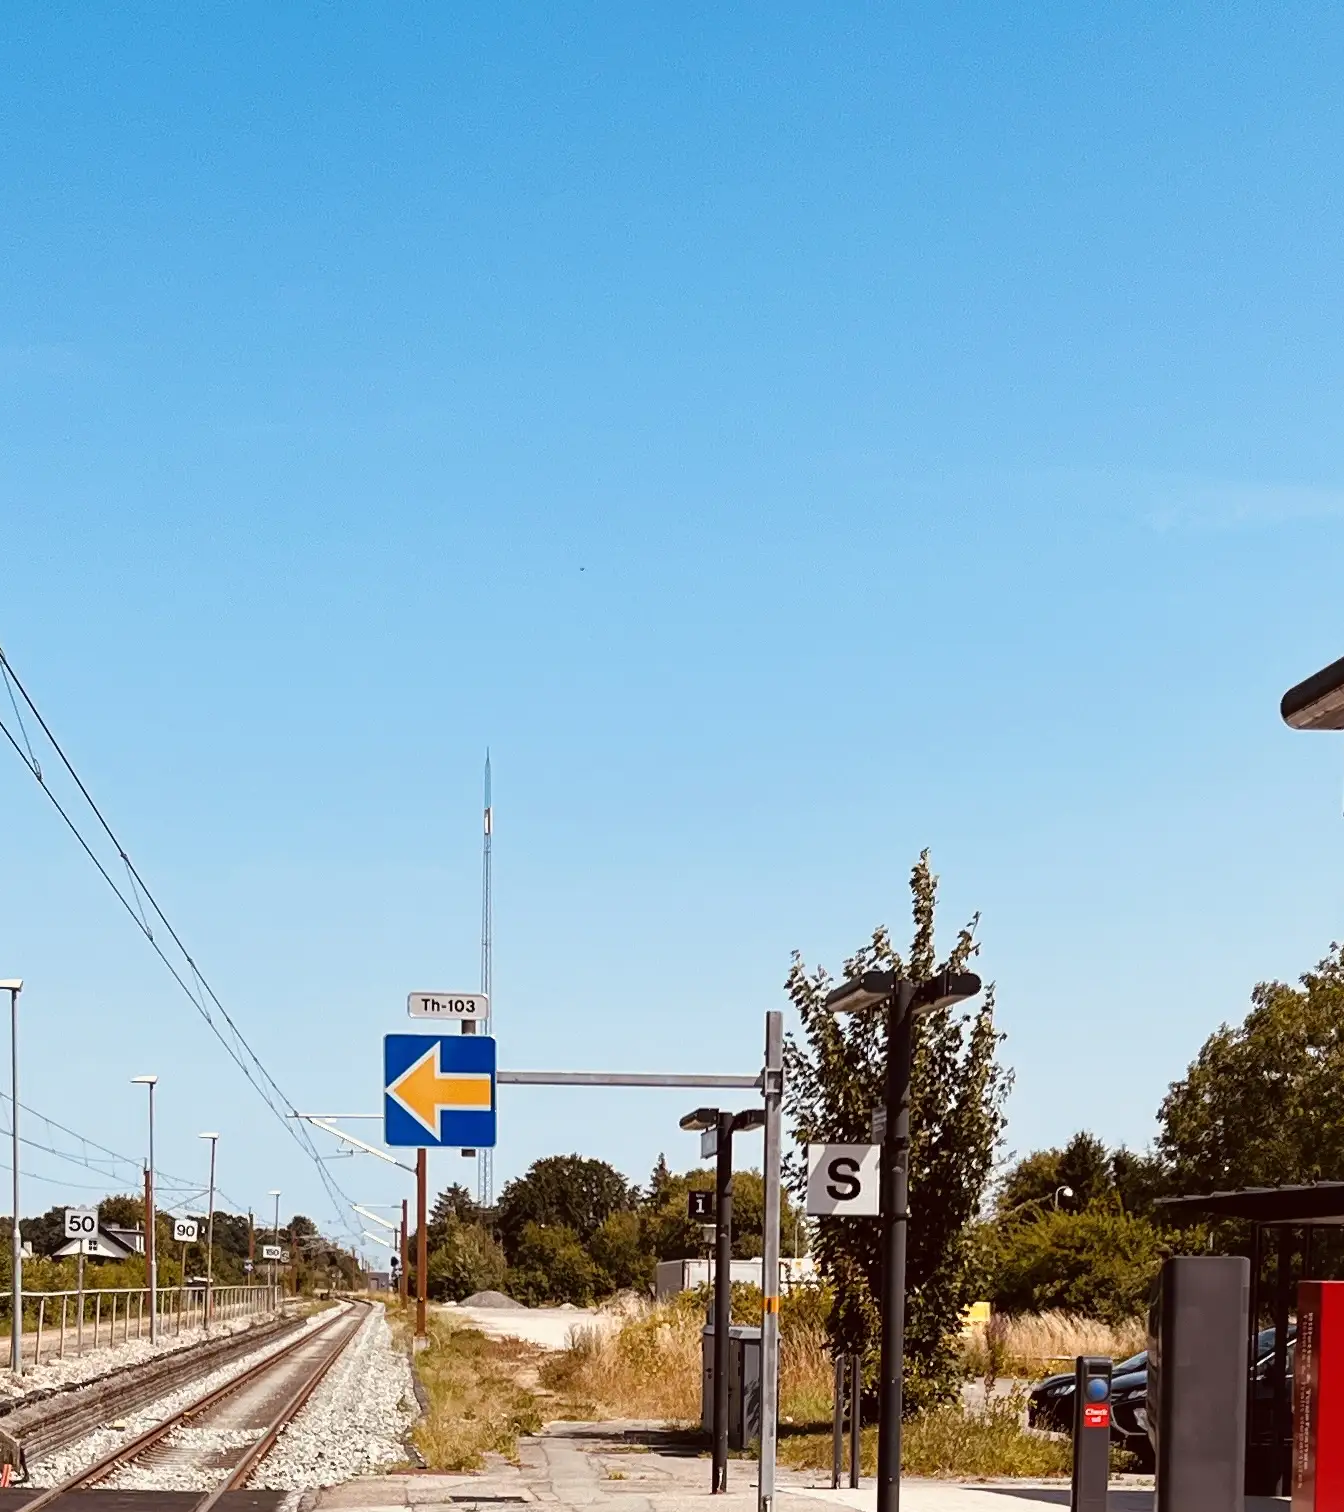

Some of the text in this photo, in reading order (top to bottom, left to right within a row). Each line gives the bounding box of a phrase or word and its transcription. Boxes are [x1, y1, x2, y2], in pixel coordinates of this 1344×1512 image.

[421, 998, 476, 1013] Th-103
[826, 1157, 861, 1201] S
[696, 1199, 705, 1213] 1
[68, 1215, 95, 1233] 50
[176, 1224, 195, 1237] 90
